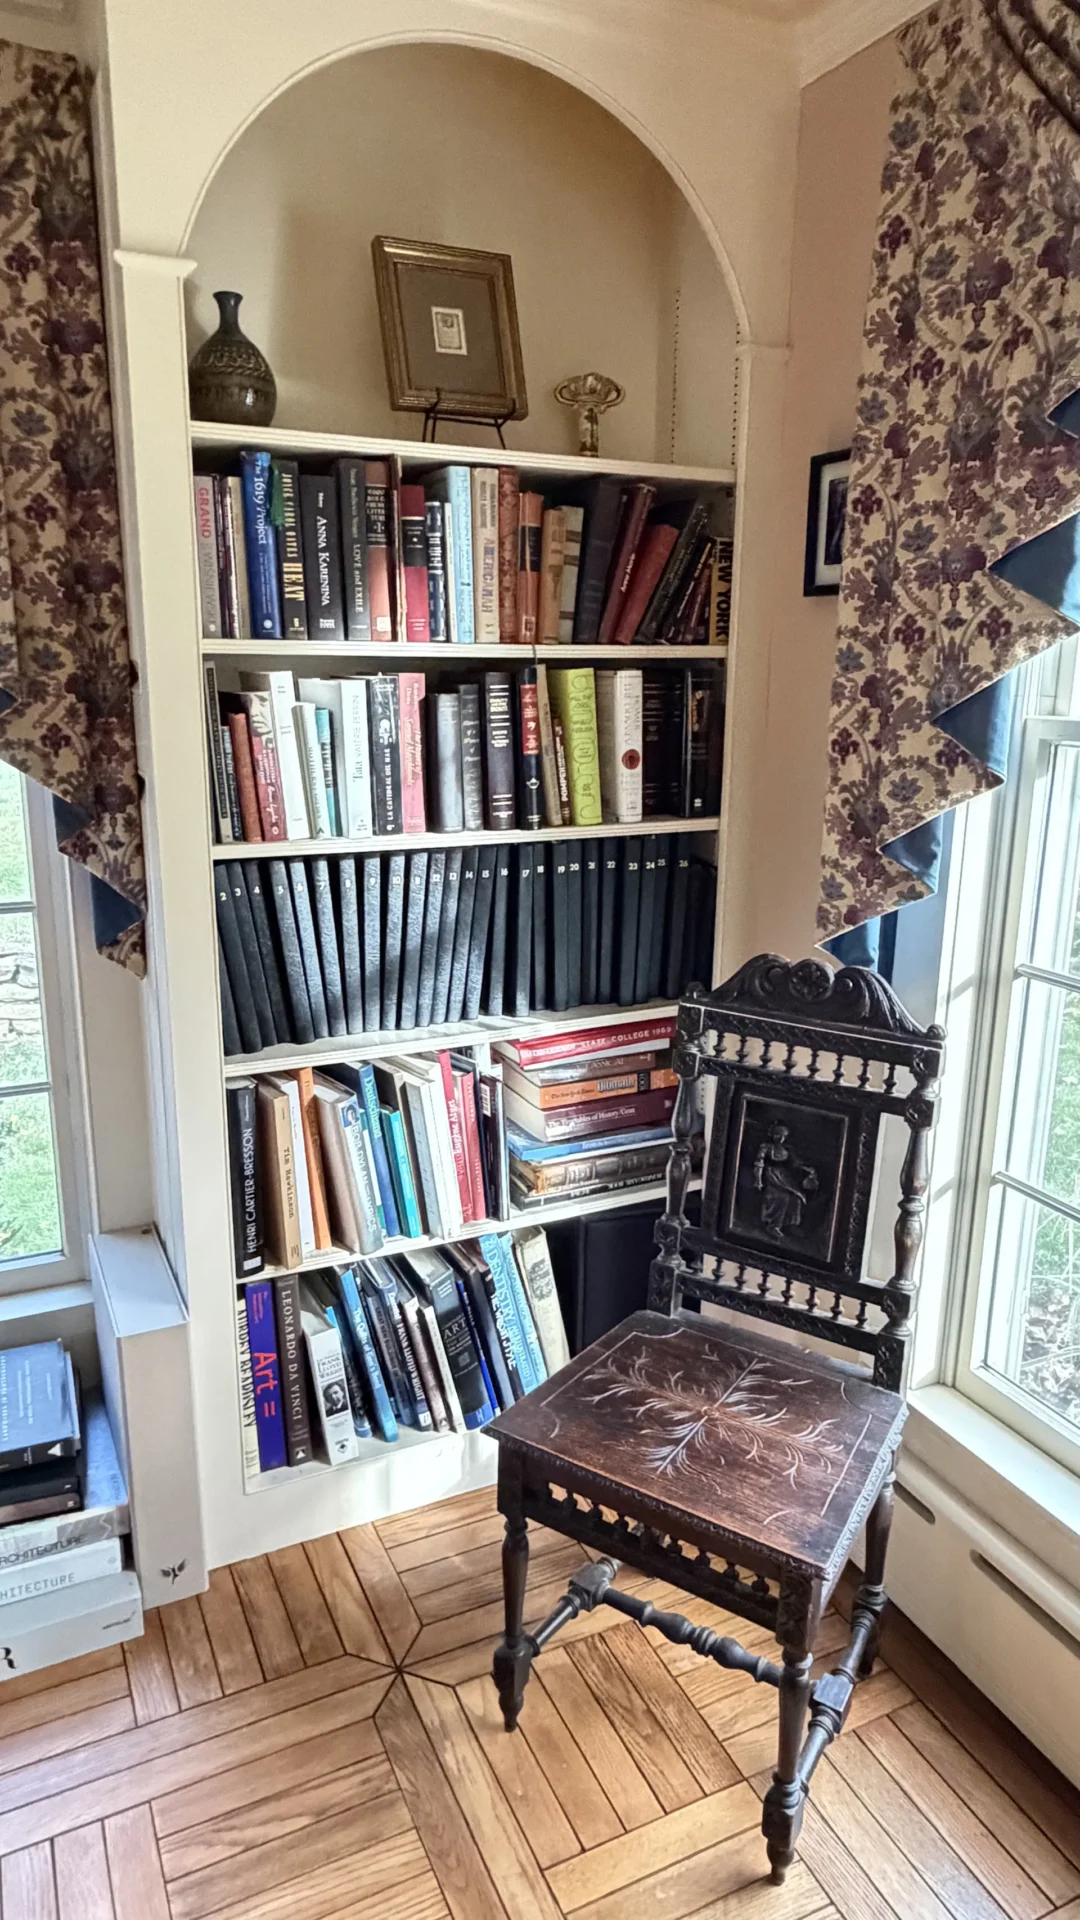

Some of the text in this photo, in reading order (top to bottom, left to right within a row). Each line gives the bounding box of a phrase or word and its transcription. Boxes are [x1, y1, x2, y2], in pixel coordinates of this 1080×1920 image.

[253, 477, 266, 505] 1619
[282, 473, 294, 498] JOYCE
[198, 487, 211, 539] GRAND
[255, 505, 267, 545] Project
[316, 515, 328, 548] ANNA
[286, 531, 298, 558] OATES
[353, 543, 362, 568] LOVE
[283, 562, 305, 601] HEAT
[318, 551, 330, 606] KARENINA
[481, 537, 495, 614] AMERICANAH
[354, 587, 363, 613] EXILE
[716, 540, 734, 641] NEW YORK
[385, 779, 393, 811] CATEDRAL
[559, 770, 568, 801] POMPEII
[386, 812, 393, 822] LA
[465, 871, 473, 879] 14
[482, 870, 489, 878] 15
[501, 868, 508, 876] 16
[522, 870, 530, 878] 17
[558, 866, 565, 874] 19
[570, 863, 579, 871] 20
[235, 888, 241, 897] 3
[254, 886, 260, 894] 4
[278, 886, 284, 894] 5
[297, 883, 303, 892] 6
[319, 882, 326, 890] 7
[345, 879, 351, 888] 8
[370, 878, 376, 886] 9
[392, 876, 401, 884] 10
[220, 892, 227, 901] 2
[580, 1038, 606, 1049] STATE
[611, 1030, 650, 1043] COLLEGE
[652, 1026, 672, 1036] 1969
[364, 1075, 382, 1139] Deutschland
[449, 1099, 458, 1124] Atget
[548, 1119, 562, 1130] The
[599, 1109, 619, 1121] History
[350, 1126, 362, 1150] BOB
[355, 1151, 369, 1185] DYLAN
[243, 1128, 258, 1253] HENRI CARTIER-BRESSON
[285, 1168, 294, 1218] Hawkinson
[487, 1249, 515, 1321] DENTISTRY
[353, 1306, 362, 1321] The
[357, 1322, 367, 1343] Quilts
[443, 1317, 467, 1339] ART
[281, 1289, 302, 1427] LEONARDO DA VINCI
[397, 1323, 409, 1349] FRANK
[404, 1347, 416, 1372] LLOYD
[411, 1371, 426, 1400] WRIGHT
[502, 1340, 517, 1371] STYLE
[253, 1352, 278, 1418] Art =
[371, 1372, 382, 1389] Bend
